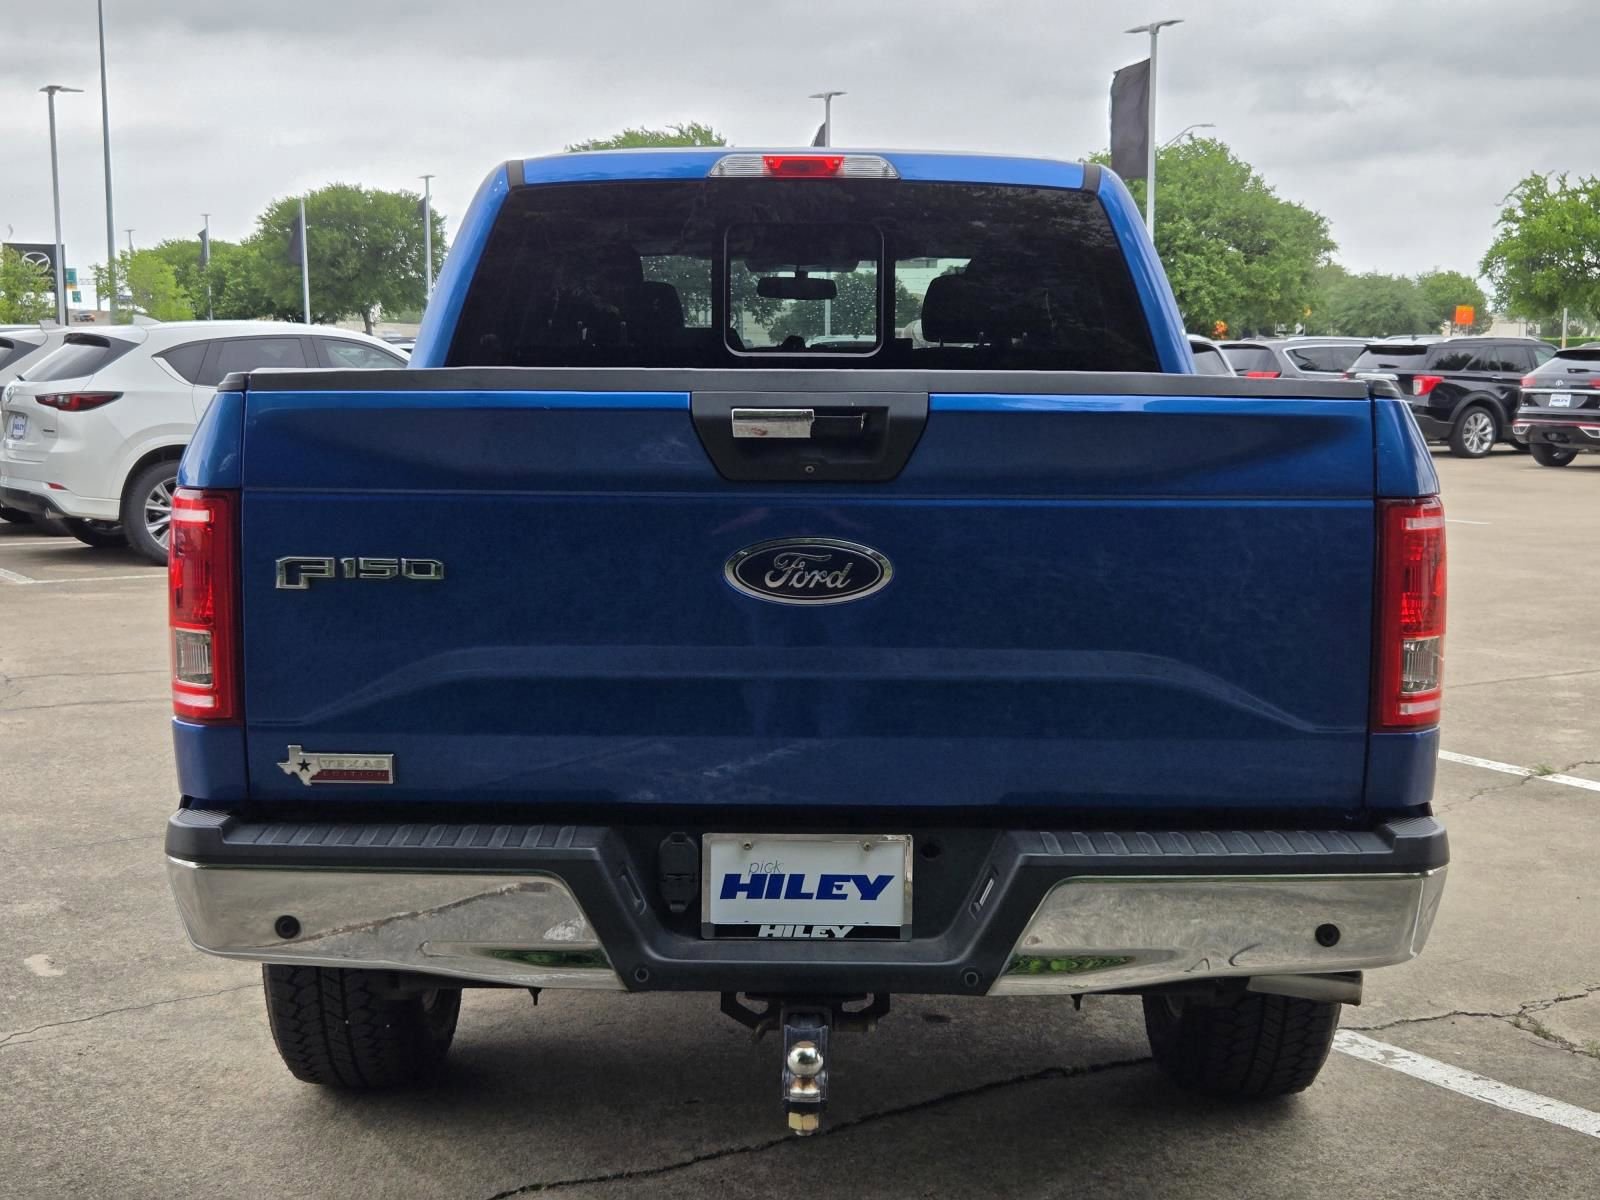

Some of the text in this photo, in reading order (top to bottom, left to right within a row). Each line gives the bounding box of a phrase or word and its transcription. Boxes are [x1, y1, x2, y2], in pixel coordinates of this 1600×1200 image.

[764, 552, 854, 588] Ford
[320, 759, 386, 769] TEXAS
[748, 860, 783, 875] pick
[719, 873, 895, 900] HILEY
[758, 924, 855, 938] HILEY
